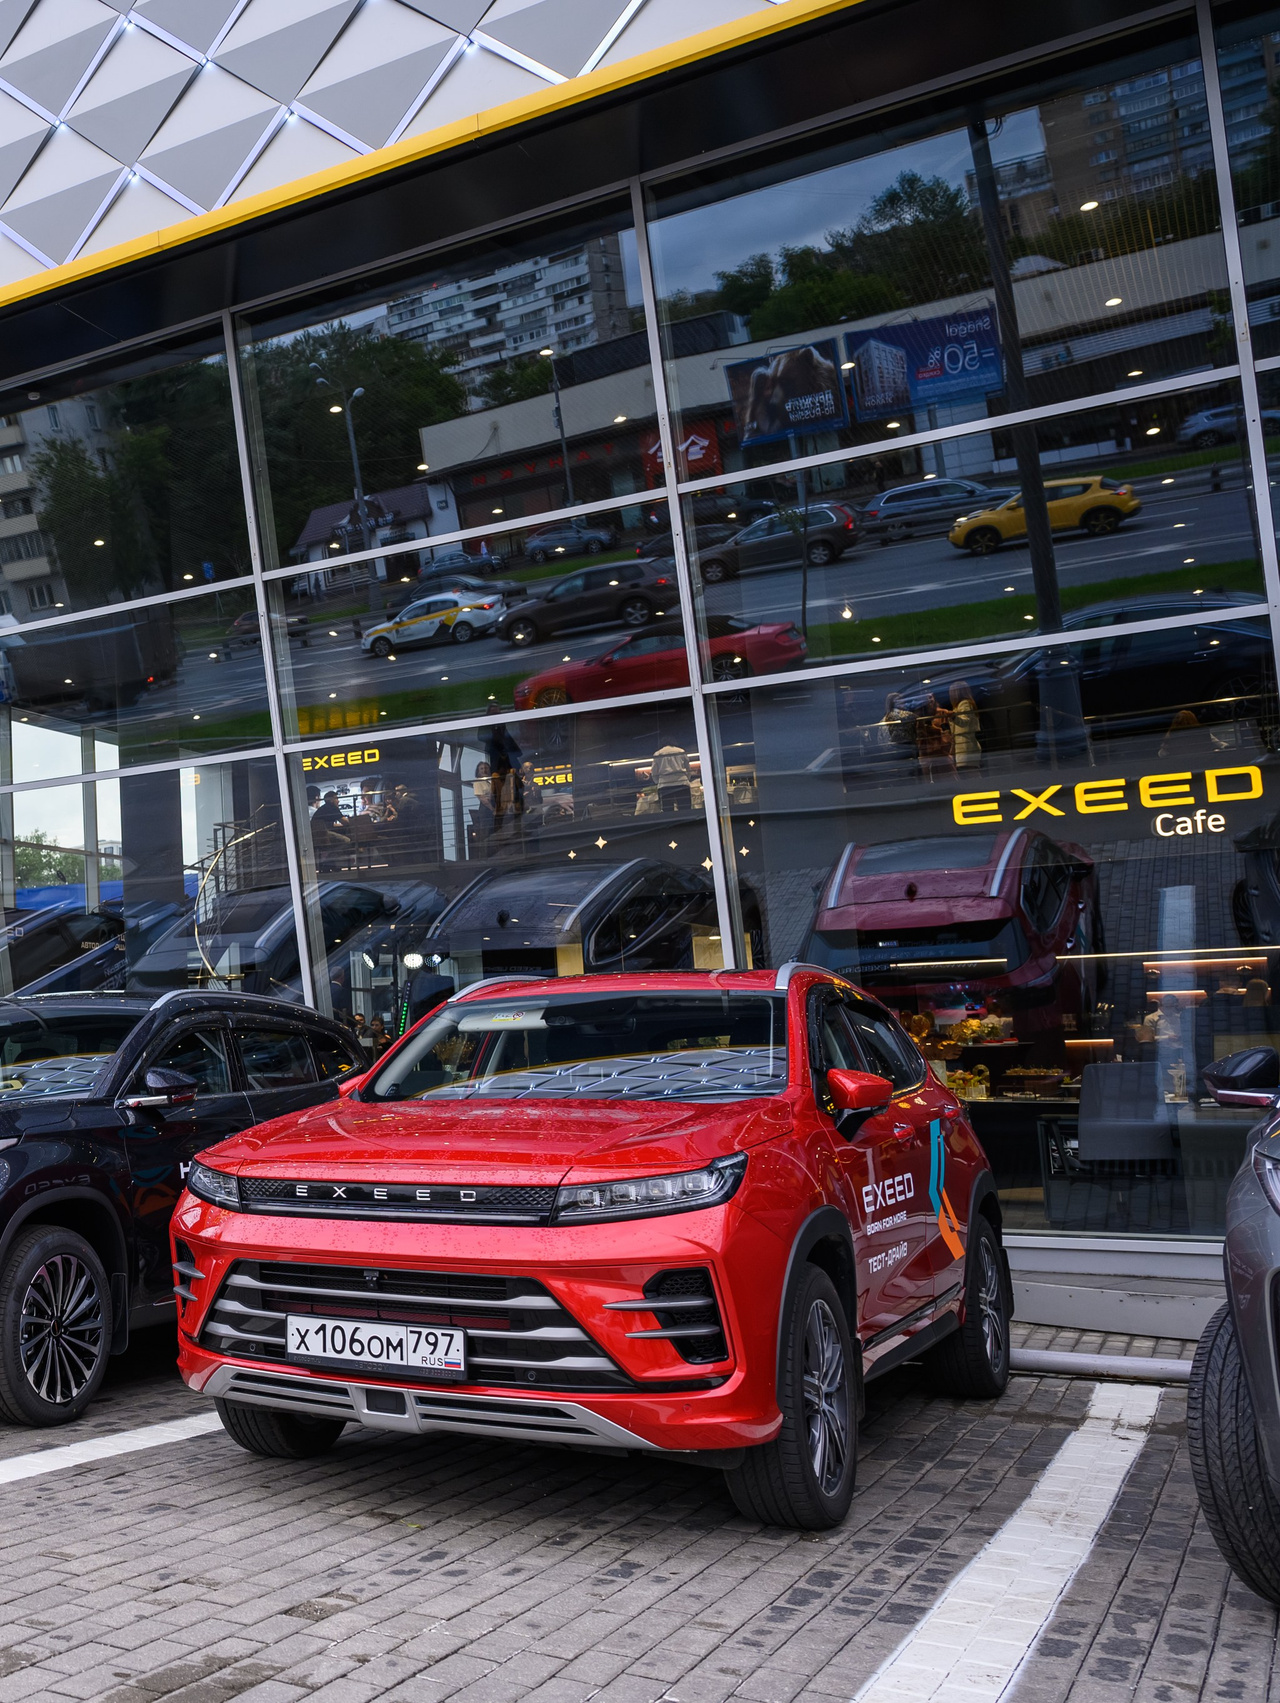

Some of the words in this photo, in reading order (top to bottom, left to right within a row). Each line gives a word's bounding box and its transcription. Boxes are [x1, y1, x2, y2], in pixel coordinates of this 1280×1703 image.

[302, 747, 381, 772] EXEED
[533, 773, 573, 786] EXEE
[952, 764, 1265, 826] EXEED
[1155, 808, 1227, 838] Cafe
[296, 1184, 477, 1202] EXEED
[861, 1172, 915, 1214] EXEED
[866, 1220, 883, 1236] BORN
[882, 1215, 894, 1229] FOR
[893, 1210, 908, 1225] MORE
[868, 1240, 908, 1274] ТЕСТ-ДРАЙВ
[12, 1319, 25, 1383] Continental
[409, 1330, 454, 1356] 797
[421, 1356, 444, 1367] RUS
